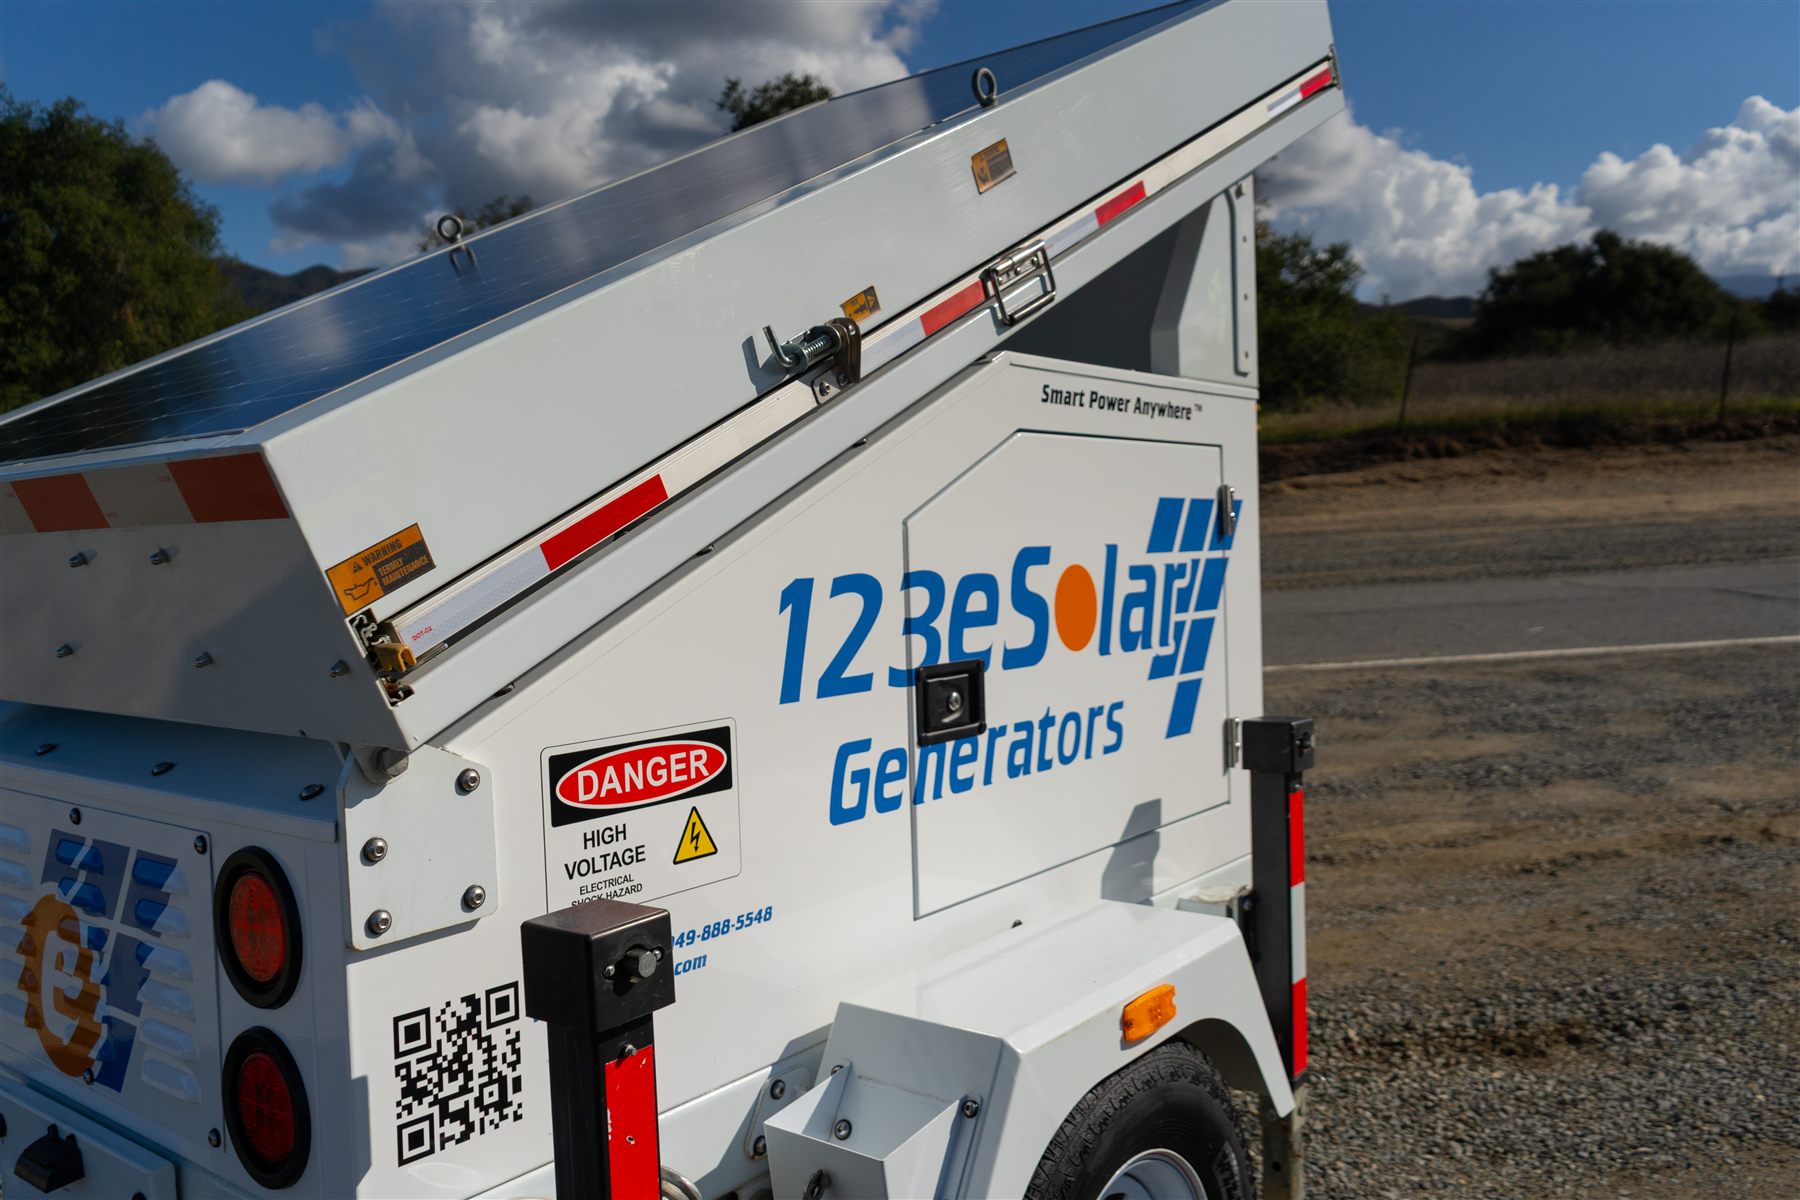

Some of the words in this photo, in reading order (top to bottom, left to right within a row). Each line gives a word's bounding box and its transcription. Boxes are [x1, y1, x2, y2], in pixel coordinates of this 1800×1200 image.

[1041, 384, 1085, 407] Smart
[1089, 391, 1131, 413] Power
[362, 538, 402, 565] WARNING
[382, 555, 429, 586] MAINTENANCE
[577, 748, 710, 803] DANGER
[829, 701, 1124, 826] Generators
[583, 823, 627, 850] HIGH
[564, 844, 647, 881] VOLTAGE
[579, 874, 635, 896] ELECTRICAL
[605, 883, 643, 900] HAZARD
